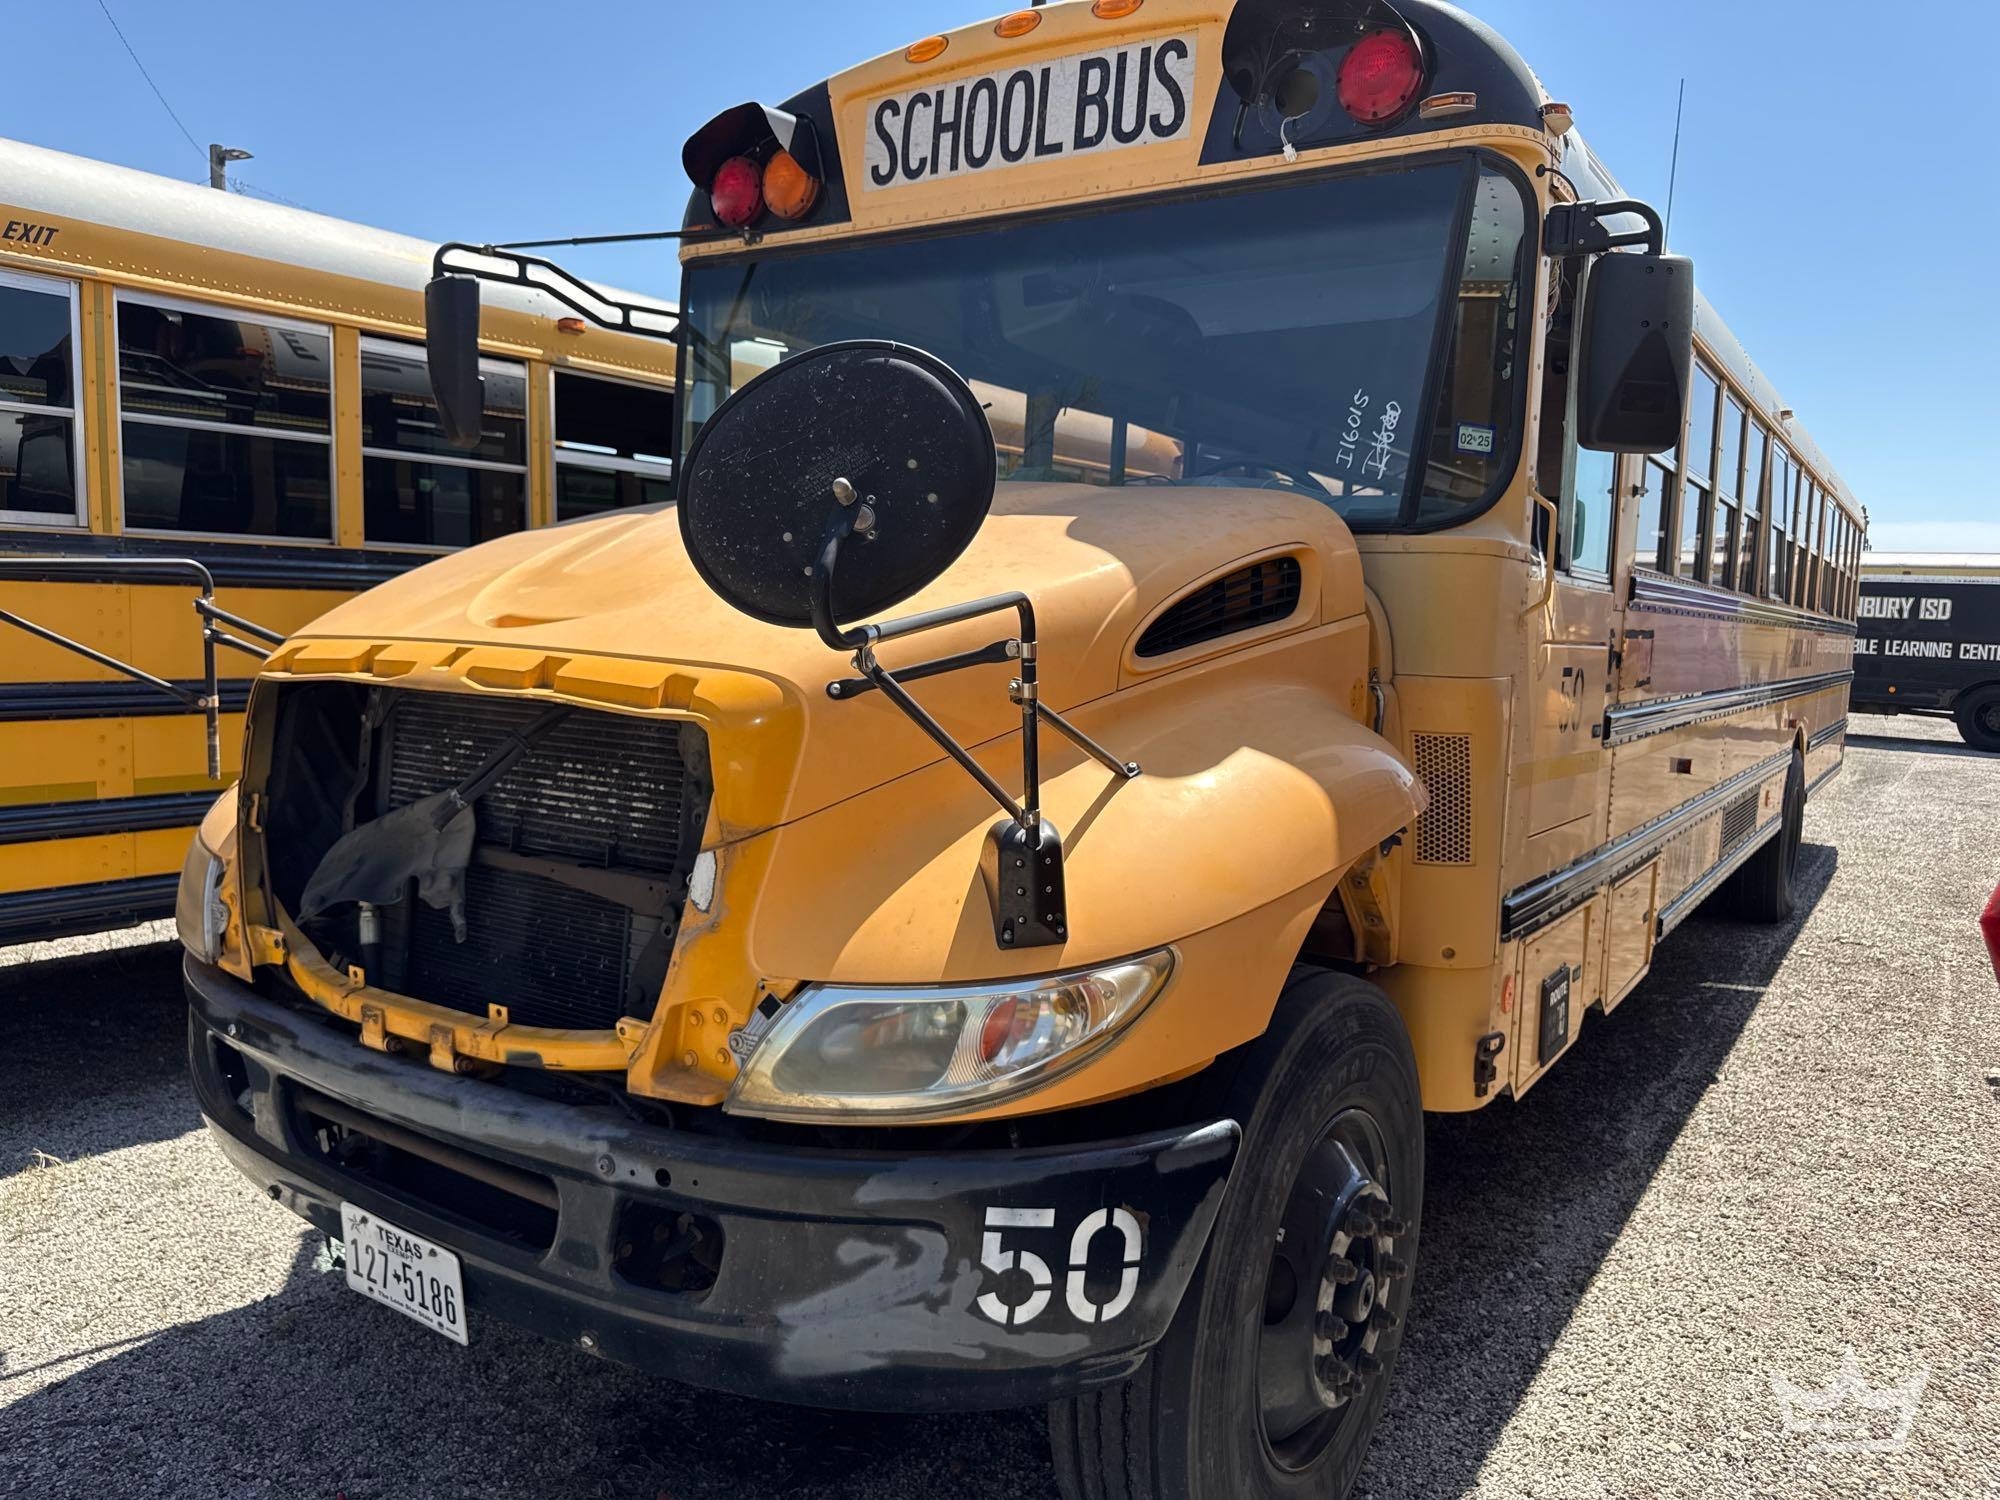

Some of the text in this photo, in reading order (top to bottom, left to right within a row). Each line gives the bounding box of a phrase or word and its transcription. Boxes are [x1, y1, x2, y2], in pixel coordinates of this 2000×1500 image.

[871, 38, 1188, 186] SCHOOL BUS
[2, 220, 59, 246] EXIT
[1919, 597, 1952, 620] ISD
[1884, 640, 1952, 658] LEARNING
[1550, 980, 1568, 1006] ROUTE
[376, 1224, 422, 1260] TEXAS
[977, 1206, 1142, 1325] 50
